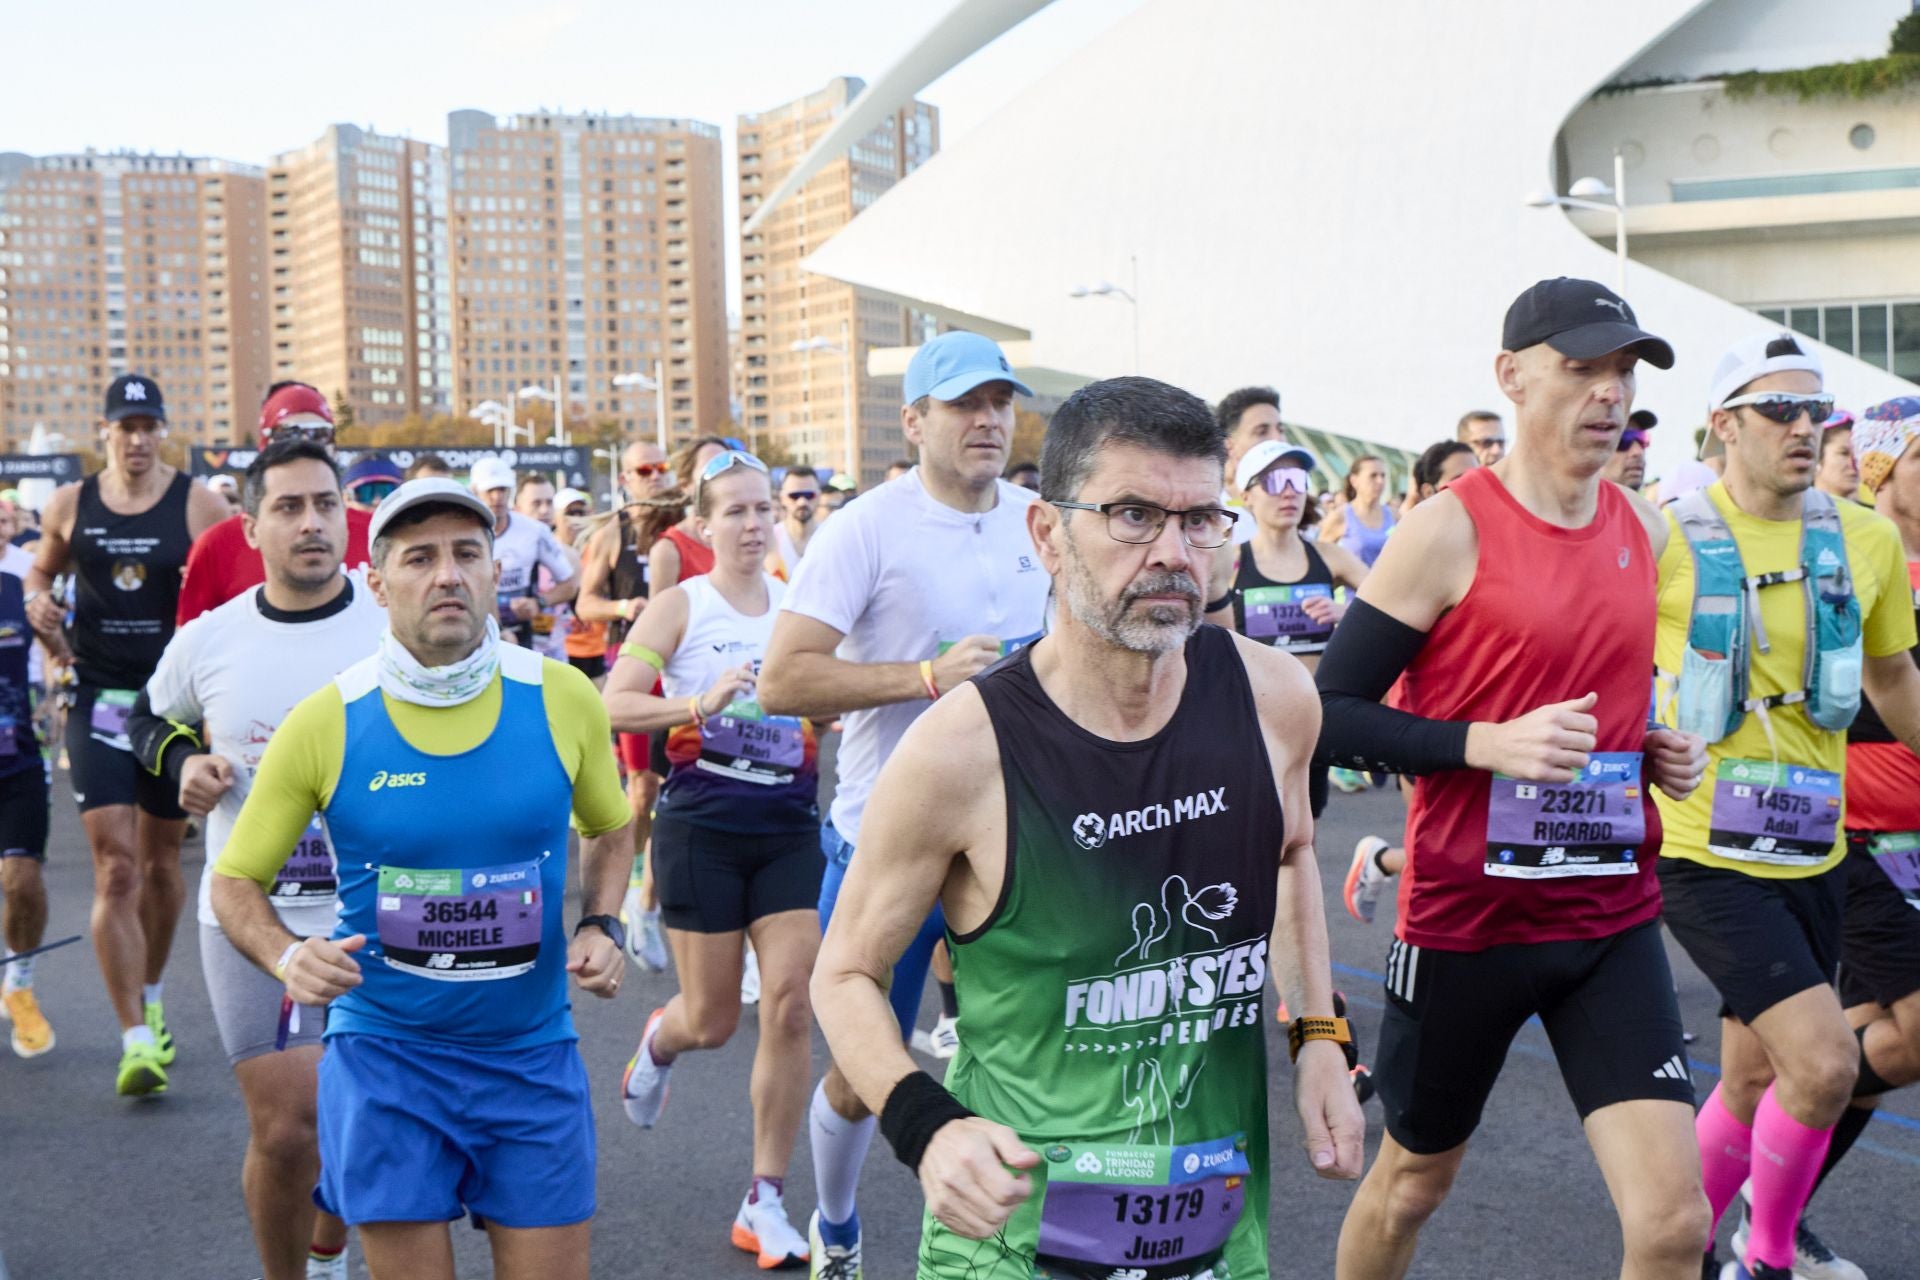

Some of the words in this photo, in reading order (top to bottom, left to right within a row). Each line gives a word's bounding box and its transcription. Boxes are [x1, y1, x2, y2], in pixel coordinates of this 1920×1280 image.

[737, 723, 782, 744] 12916
[742, 743, 771, 759] Mari
[1174, 786, 1226, 823] MAX
[1540, 789, 1606, 814] 23271
[1756, 790, 1812, 815] 14575
[1533, 821, 1613, 841] RICARDO
[1763, 817, 1799, 835] Adal
[489, 871, 526, 884] ZURICH
[422, 899, 498, 923] 36544
[417, 927, 504, 948] MICHELE
[1105, 1158, 1155, 1169] TRINIDAD
[1202, 1149, 1234, 1168] ZURICH
[1105, 1168, 1154, 1178] ALFONSO
[1113, 1188, 1205, 1225] 13179
[1124, 1236, 1184, 1261] Juan
